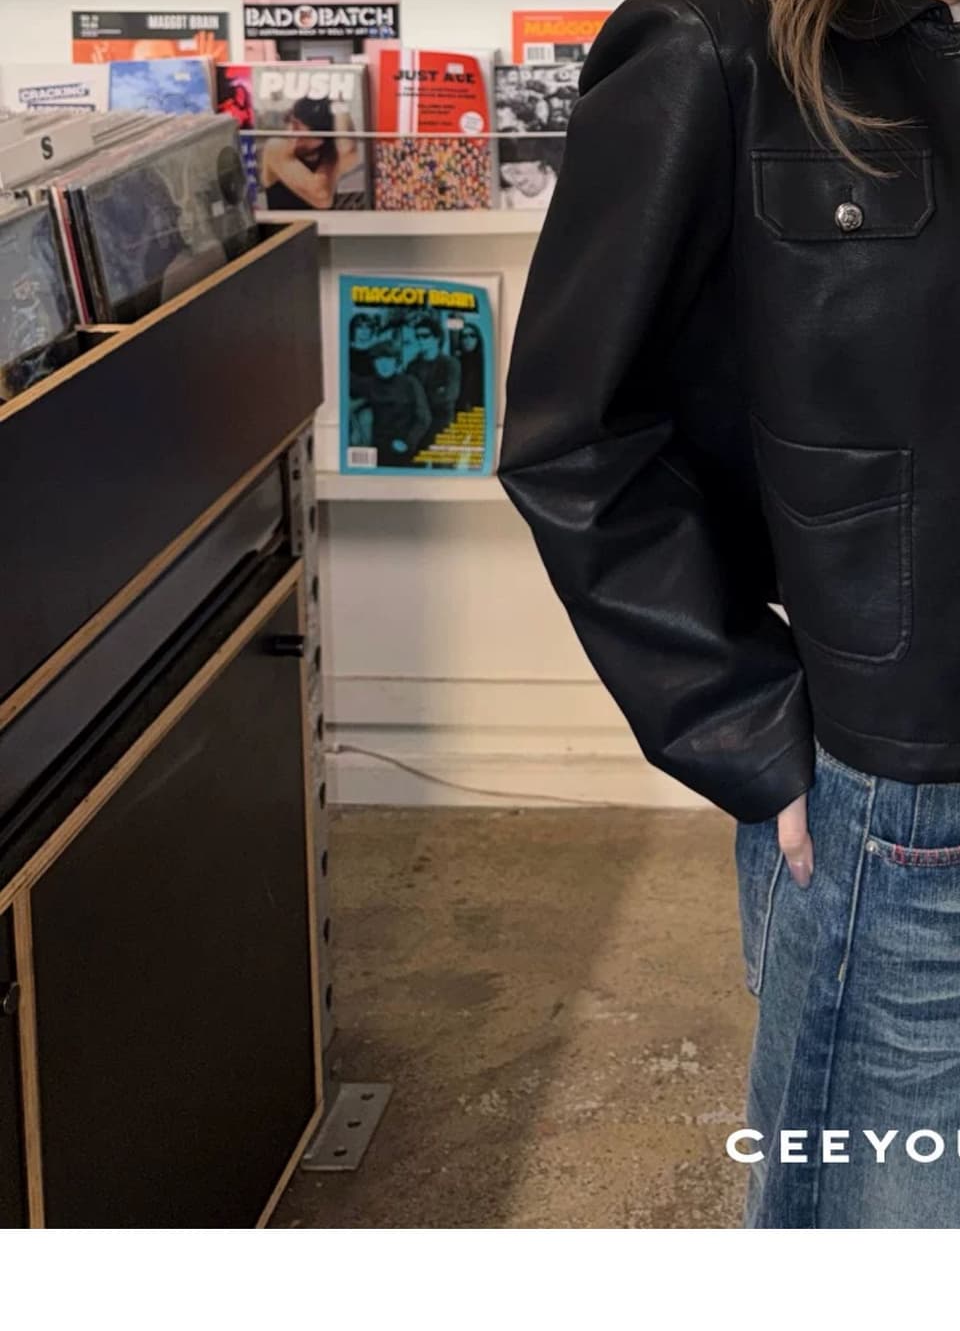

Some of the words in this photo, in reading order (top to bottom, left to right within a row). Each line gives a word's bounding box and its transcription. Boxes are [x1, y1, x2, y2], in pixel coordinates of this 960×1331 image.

[245, 7, 294, 27] BAD
[318, 6, 394, 26] BATCH
[260, 71, 355, 101] PUSH
[393, 69, 438, 81] JUST
[40, 136, 54, 160] S
[352, 284, 426, 306] MAGGOT
